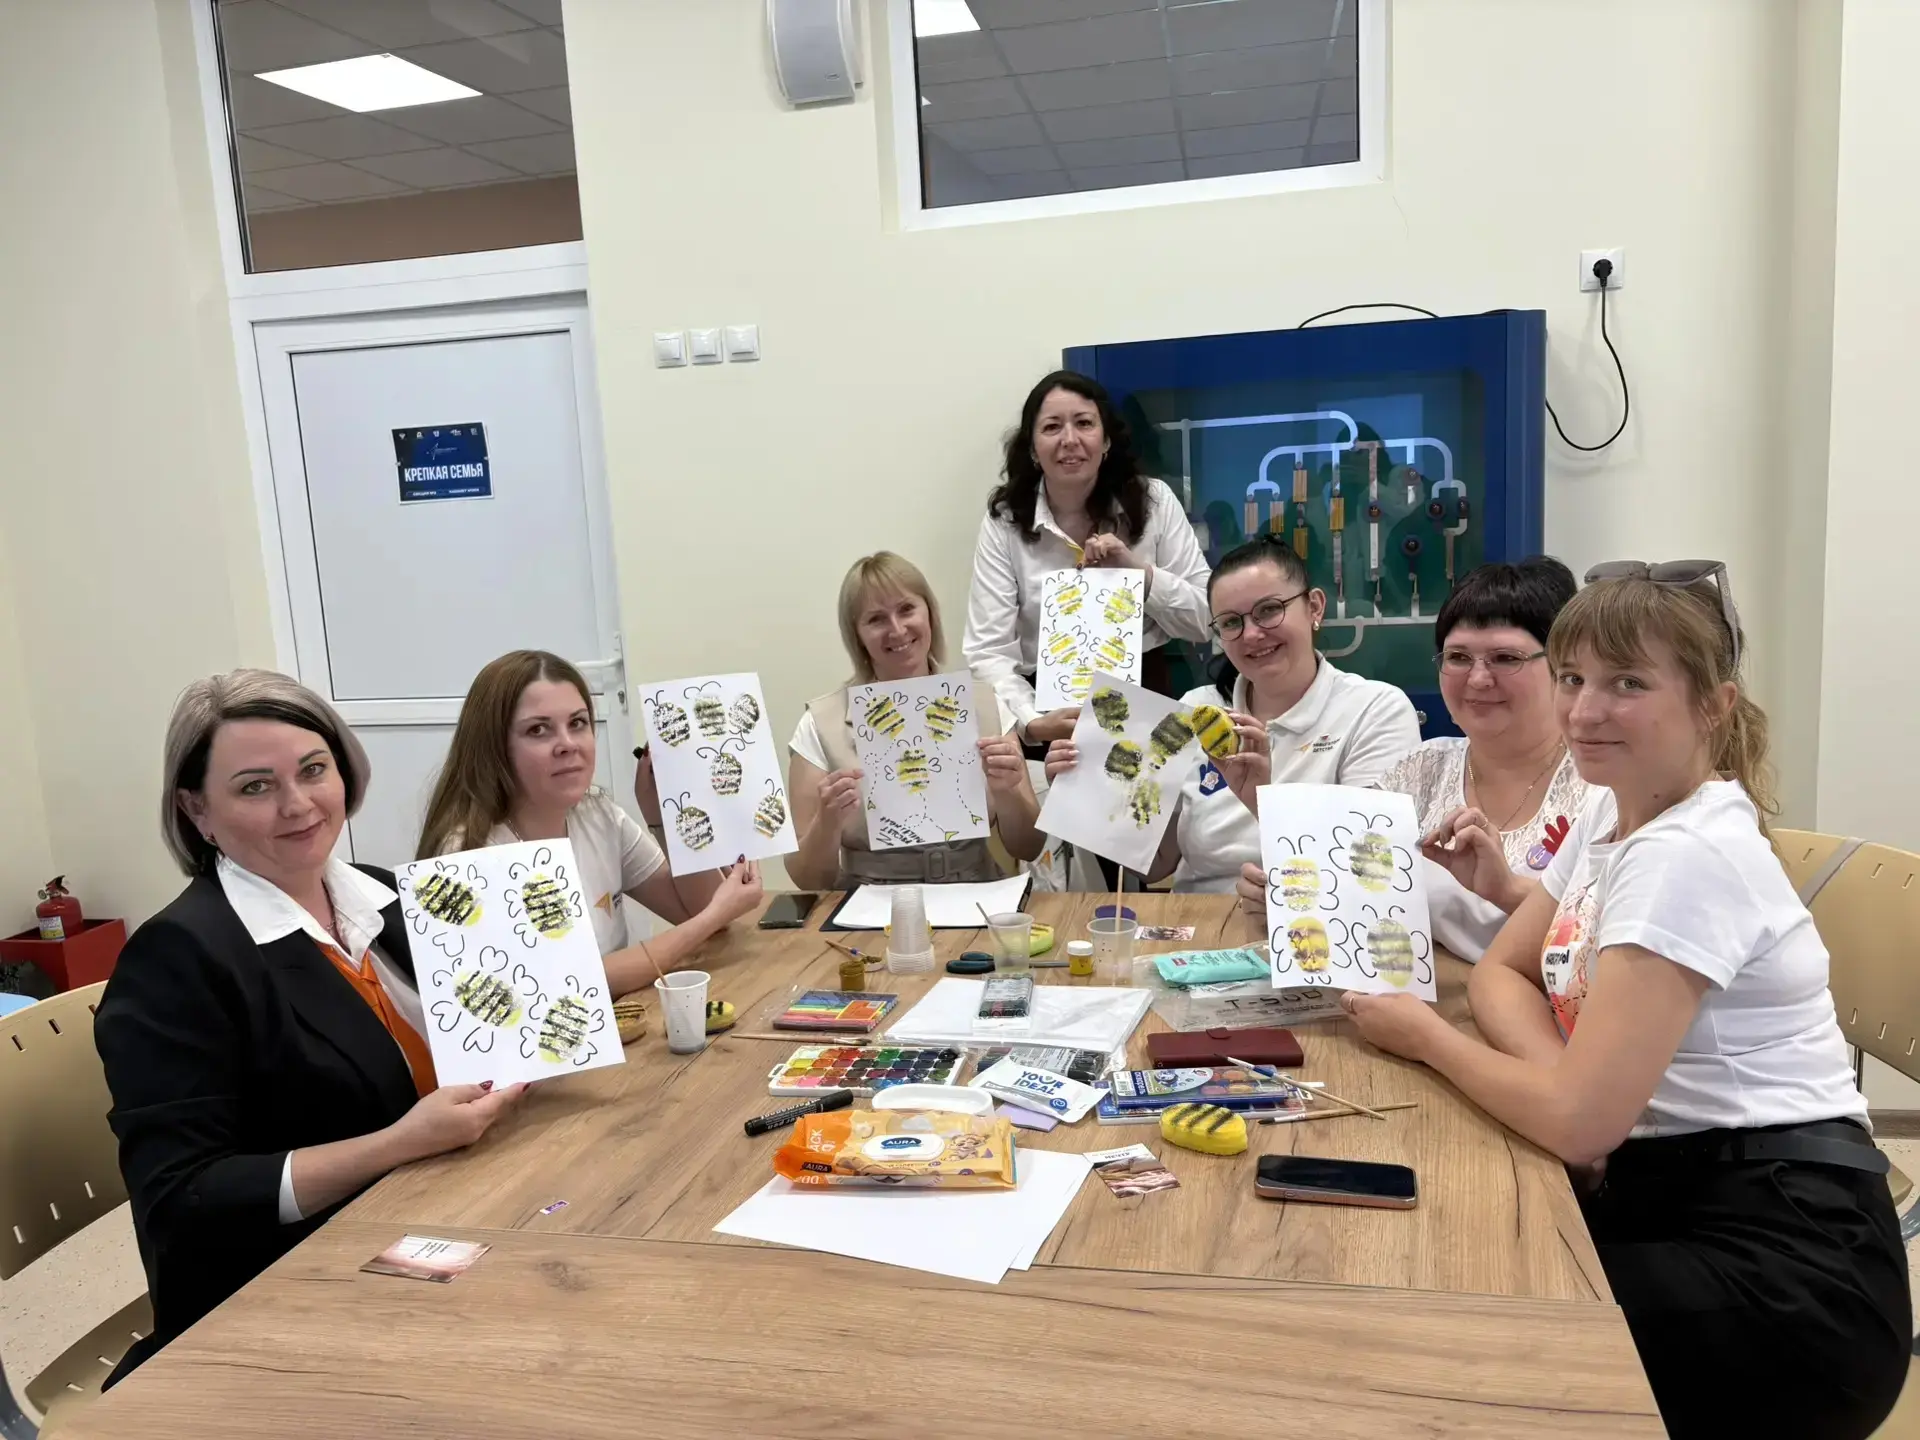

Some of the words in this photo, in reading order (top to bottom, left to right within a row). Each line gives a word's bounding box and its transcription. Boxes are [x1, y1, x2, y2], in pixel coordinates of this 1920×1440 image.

[404, 466, 448, 482] КРЕПКАЯ
[450, 463, 484, 479] СЕМЬЯ
[1013, 1078, 1055, 1096] IDEAL
[1021, 1070, 1065, 1089] YOUR
[809, 1128, 824, 1153] ACK
[805, 1163, 829, 1173] AURA
